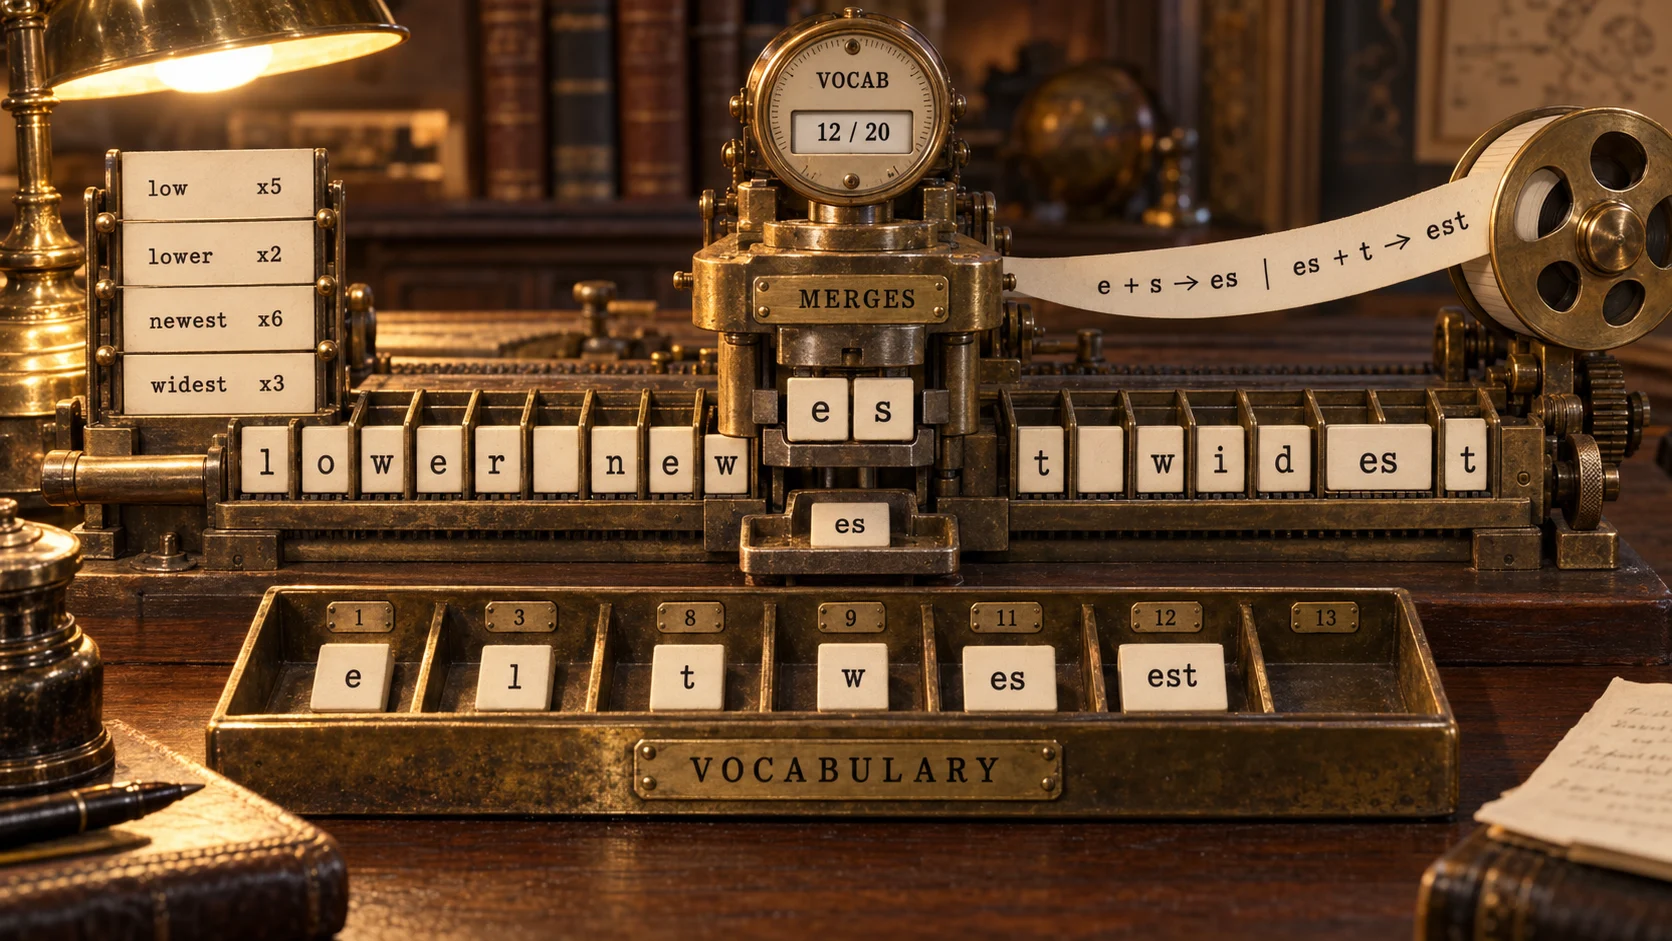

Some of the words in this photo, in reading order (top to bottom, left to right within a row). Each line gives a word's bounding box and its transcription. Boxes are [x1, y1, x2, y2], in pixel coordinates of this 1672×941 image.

[815, 71, 889, 89] VOCAB
[817, 122, 841, 142] 12
[865, 122, 890, 142] 20
[148, 179, 189, 197] low
[256, 177, 282, 195] x5
[148, 247, 214, 265] lower
[256, 245, 282, 263] x2
[1097, 280, 1111, 295] e
[1150, 278, 1162, 294] s
[1210, 272, 1238, 290] es
[1293, 257, 1320, 276] es
[1359, 241, 1373, 261] t
[1426, 211, 1469, 240] est
[798, 288, 915, 309] MERGES
[149, 312, 227, 329] newest
[257, 309, 283, 327] x6
[150, 375, 227, 394] widest
[259, 374, 285, 392] x3
[835, 518, 866, 534] es
[355, 608, 364, 626] 1
[513, 608, 525, 626] 3
[684, 609, 696, 627] 8
[845, 609, 857, 627] 9
[996, 609, 1017, 627] 11
[1155, 609, 1176, 626] 12
[1316, 609, 1337, 627] 13
[345, 669, 362, 689] e
[679, 664, 695, 690] t
[841, 668, 866, 688] w
[990, 671, 1025, 691] es
[1147, 663, 1198, 688] est
[689, 756, 1000, 784] VOCABULARY
